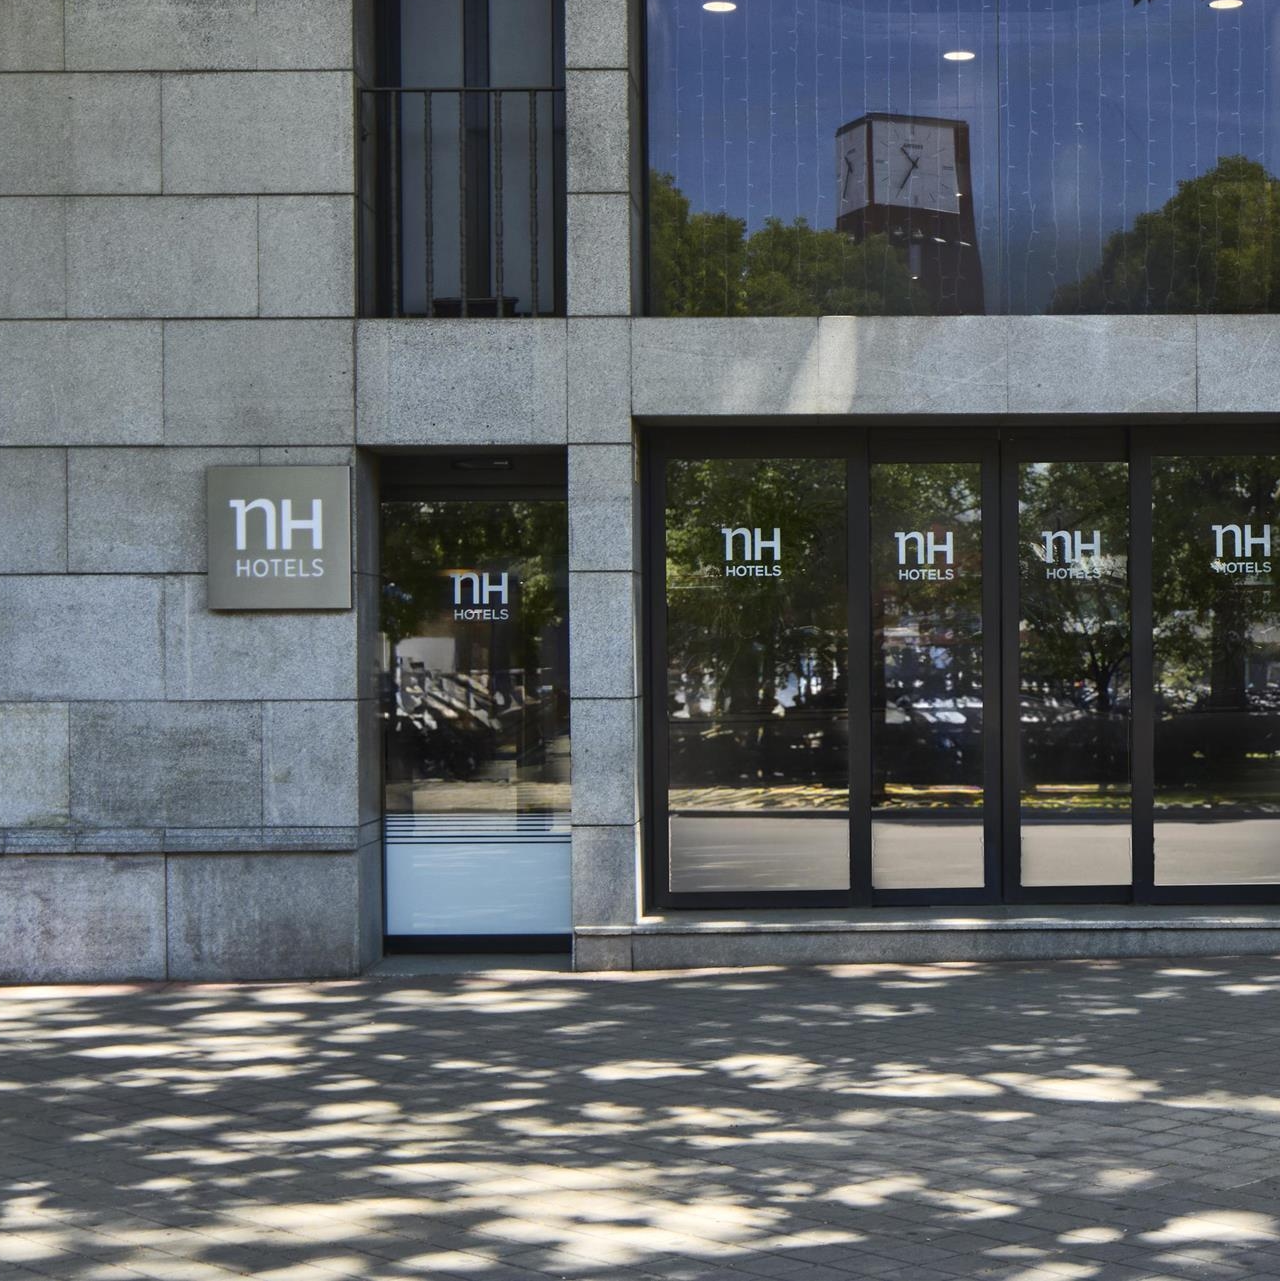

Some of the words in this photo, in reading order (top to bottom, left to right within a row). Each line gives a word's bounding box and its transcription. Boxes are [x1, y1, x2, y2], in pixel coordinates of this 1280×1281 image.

[236, 558, 324, 578] HOTELS
[725, 565, 782, 577] HOTELS
[1046, 567, 1102, 580] HOTELS
[1216, 561, 1272, 574] HOTELS
[898, 568, 955, 581] HOTELS
[454, 608, 509, 620] HOTELS
